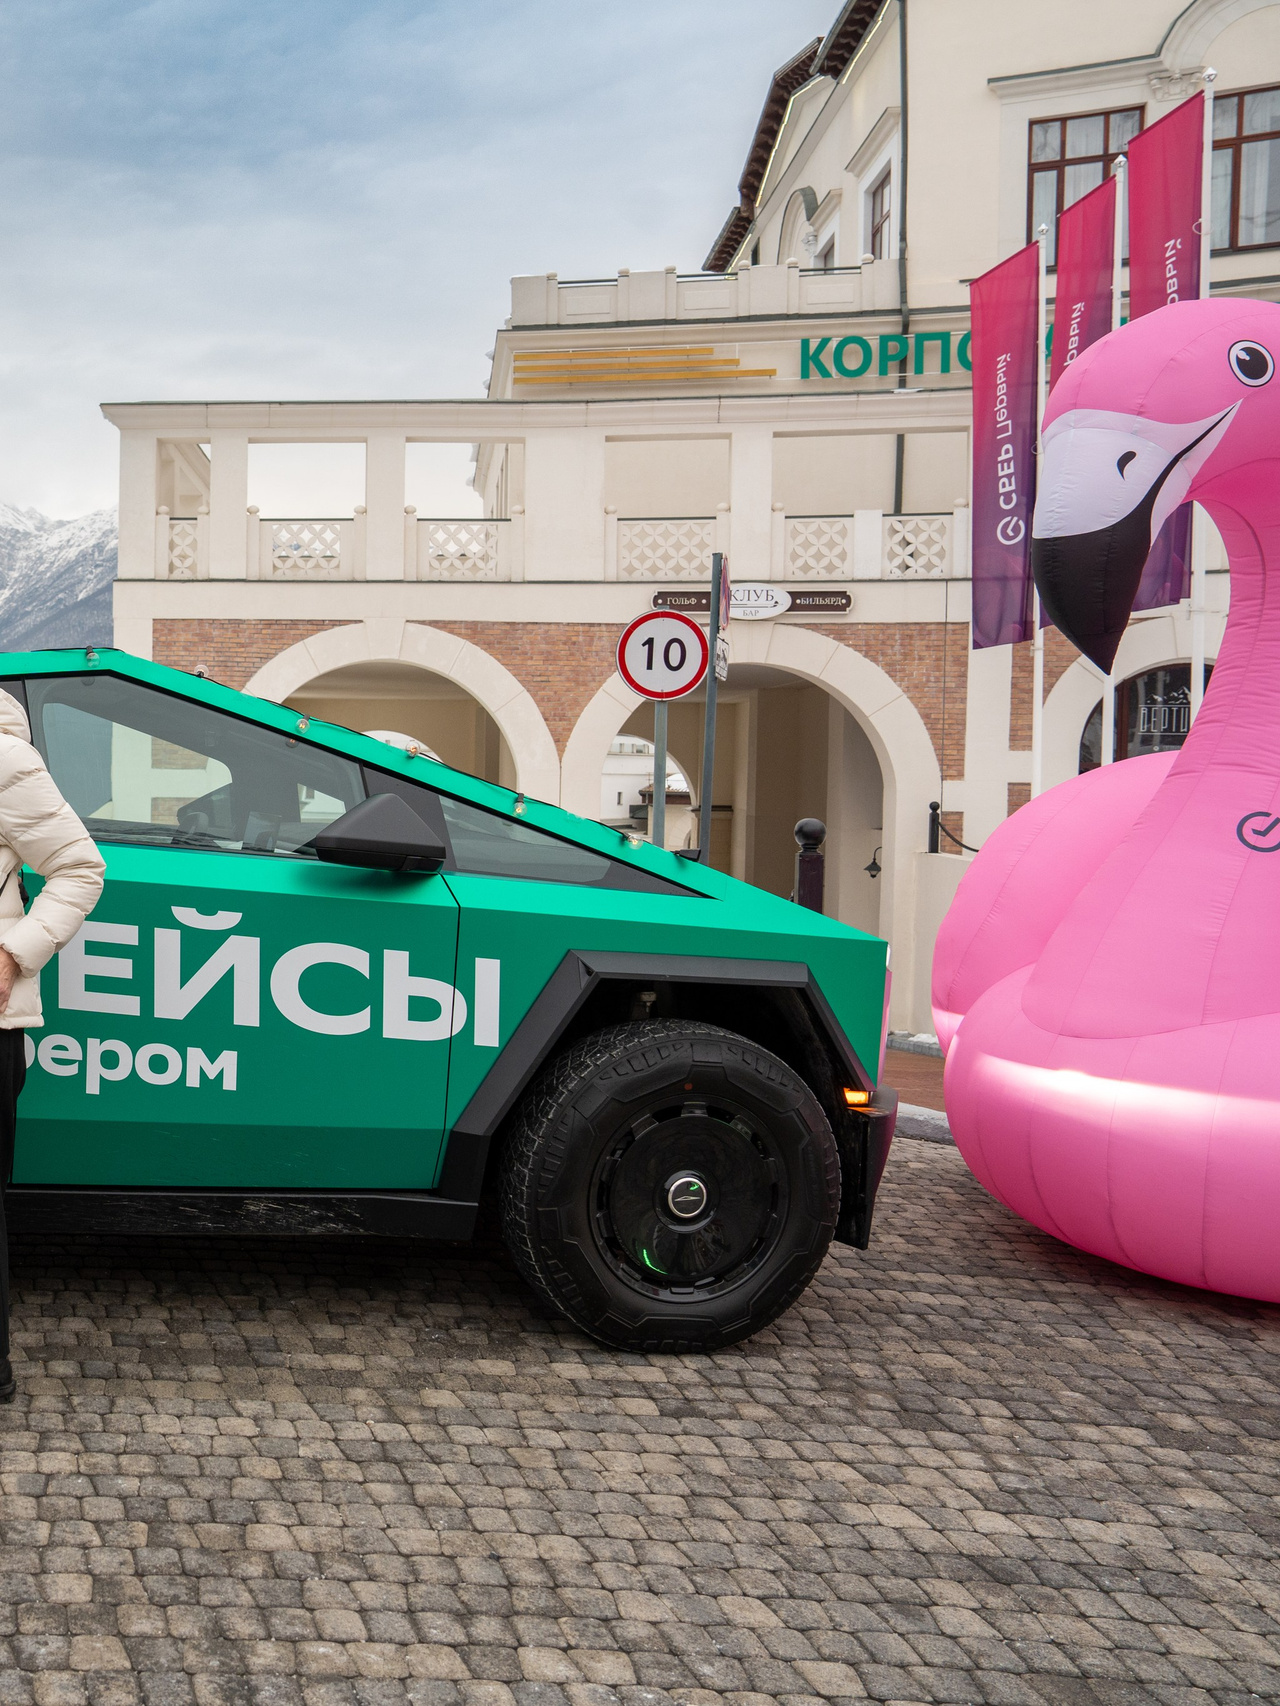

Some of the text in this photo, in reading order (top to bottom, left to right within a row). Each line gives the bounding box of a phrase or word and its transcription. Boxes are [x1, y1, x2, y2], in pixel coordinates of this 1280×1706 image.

[666, 597, 697, 606] ГОЛЬФ
[729, 589, 775, 602] КЛУБ
[800, 597, 842, 606] БИЛЬЯРД
[742, 609, 760, 617] БАР
[641, 636, 687, 672] 10
[34, 905, 501, 1047] ЕЙСЫ
[24, 1034, 238, 1095] ером
